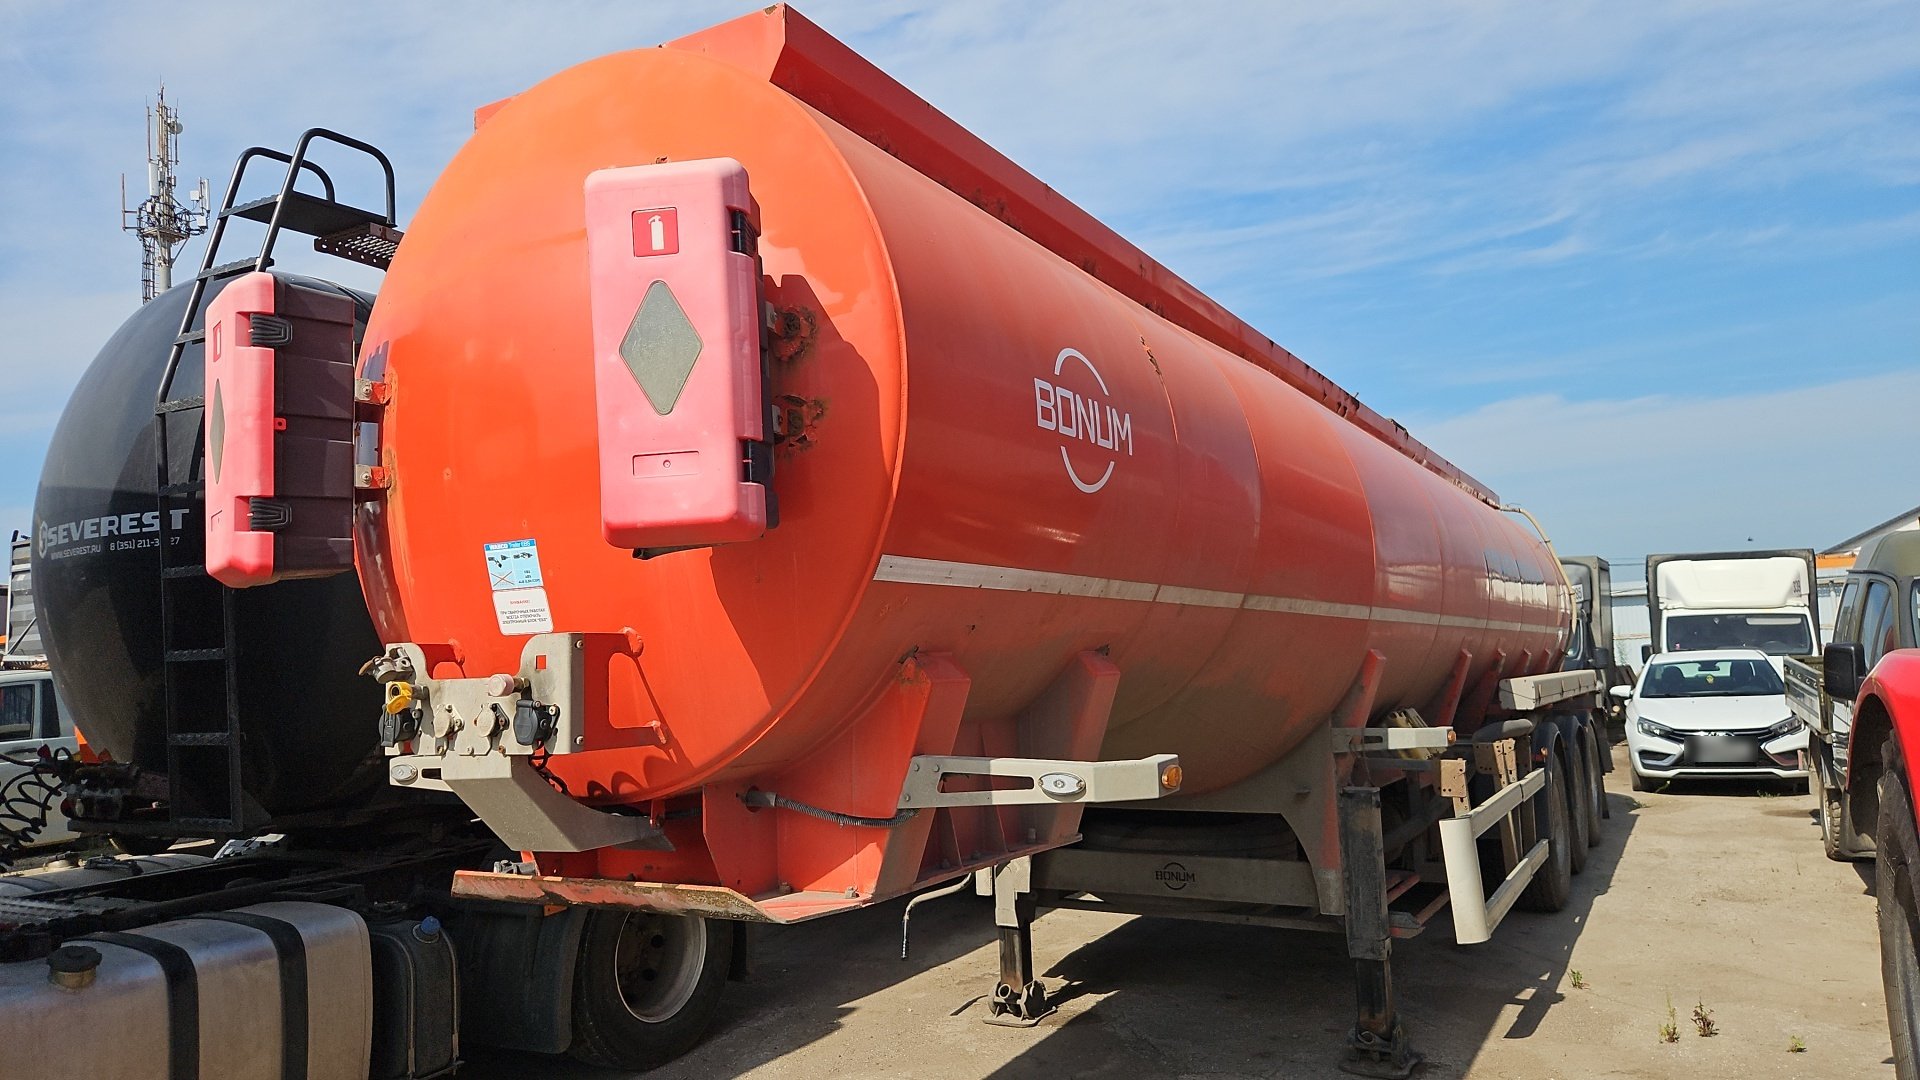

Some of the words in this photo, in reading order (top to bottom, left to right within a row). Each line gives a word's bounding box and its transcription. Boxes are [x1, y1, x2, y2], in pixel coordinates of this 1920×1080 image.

[1034, 377, 1133, 456] BONUM
[47, 508, 190, 547] SEVEREST
[109, 542, 115, 551] 8
[117, 539, 136, 551] (351)
[1155, 870, 1195, 882] BONUM
